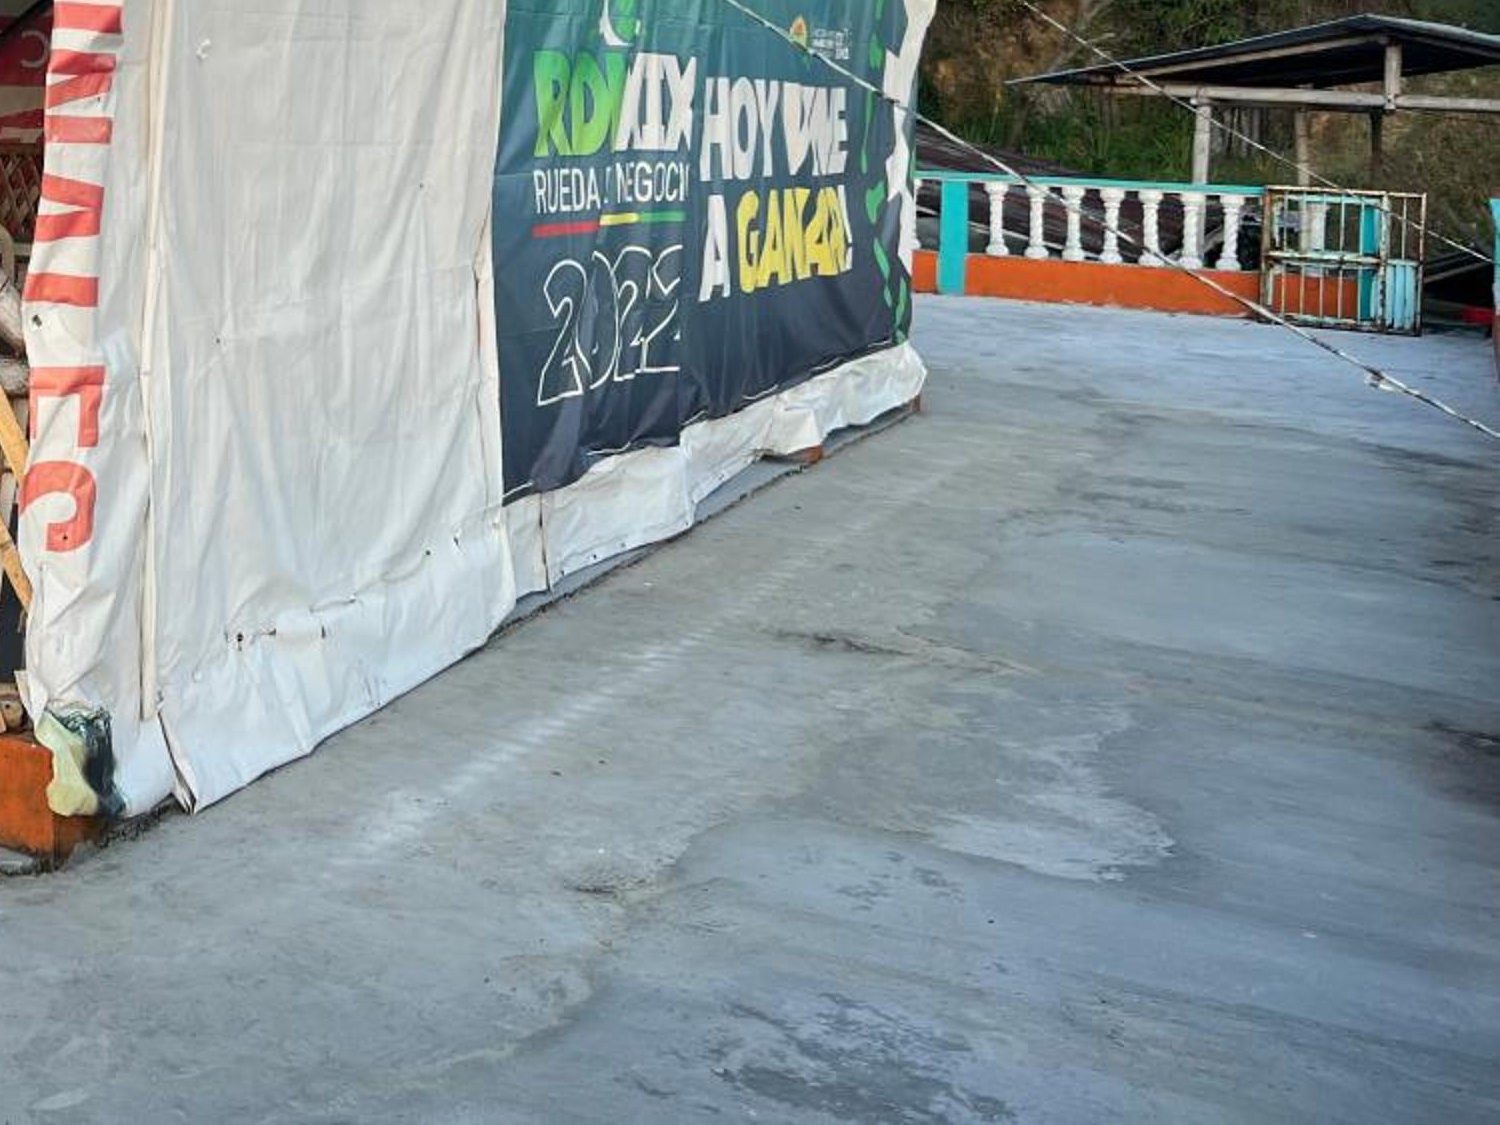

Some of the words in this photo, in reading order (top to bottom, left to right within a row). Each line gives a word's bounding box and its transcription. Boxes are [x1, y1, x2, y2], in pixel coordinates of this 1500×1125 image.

[699, 76, 779, 182] HOY
[533, 166, 601, 215] RUEDA
[615, 160, 690, 204] NEGOCI
[698, 194, 732, 302] A
